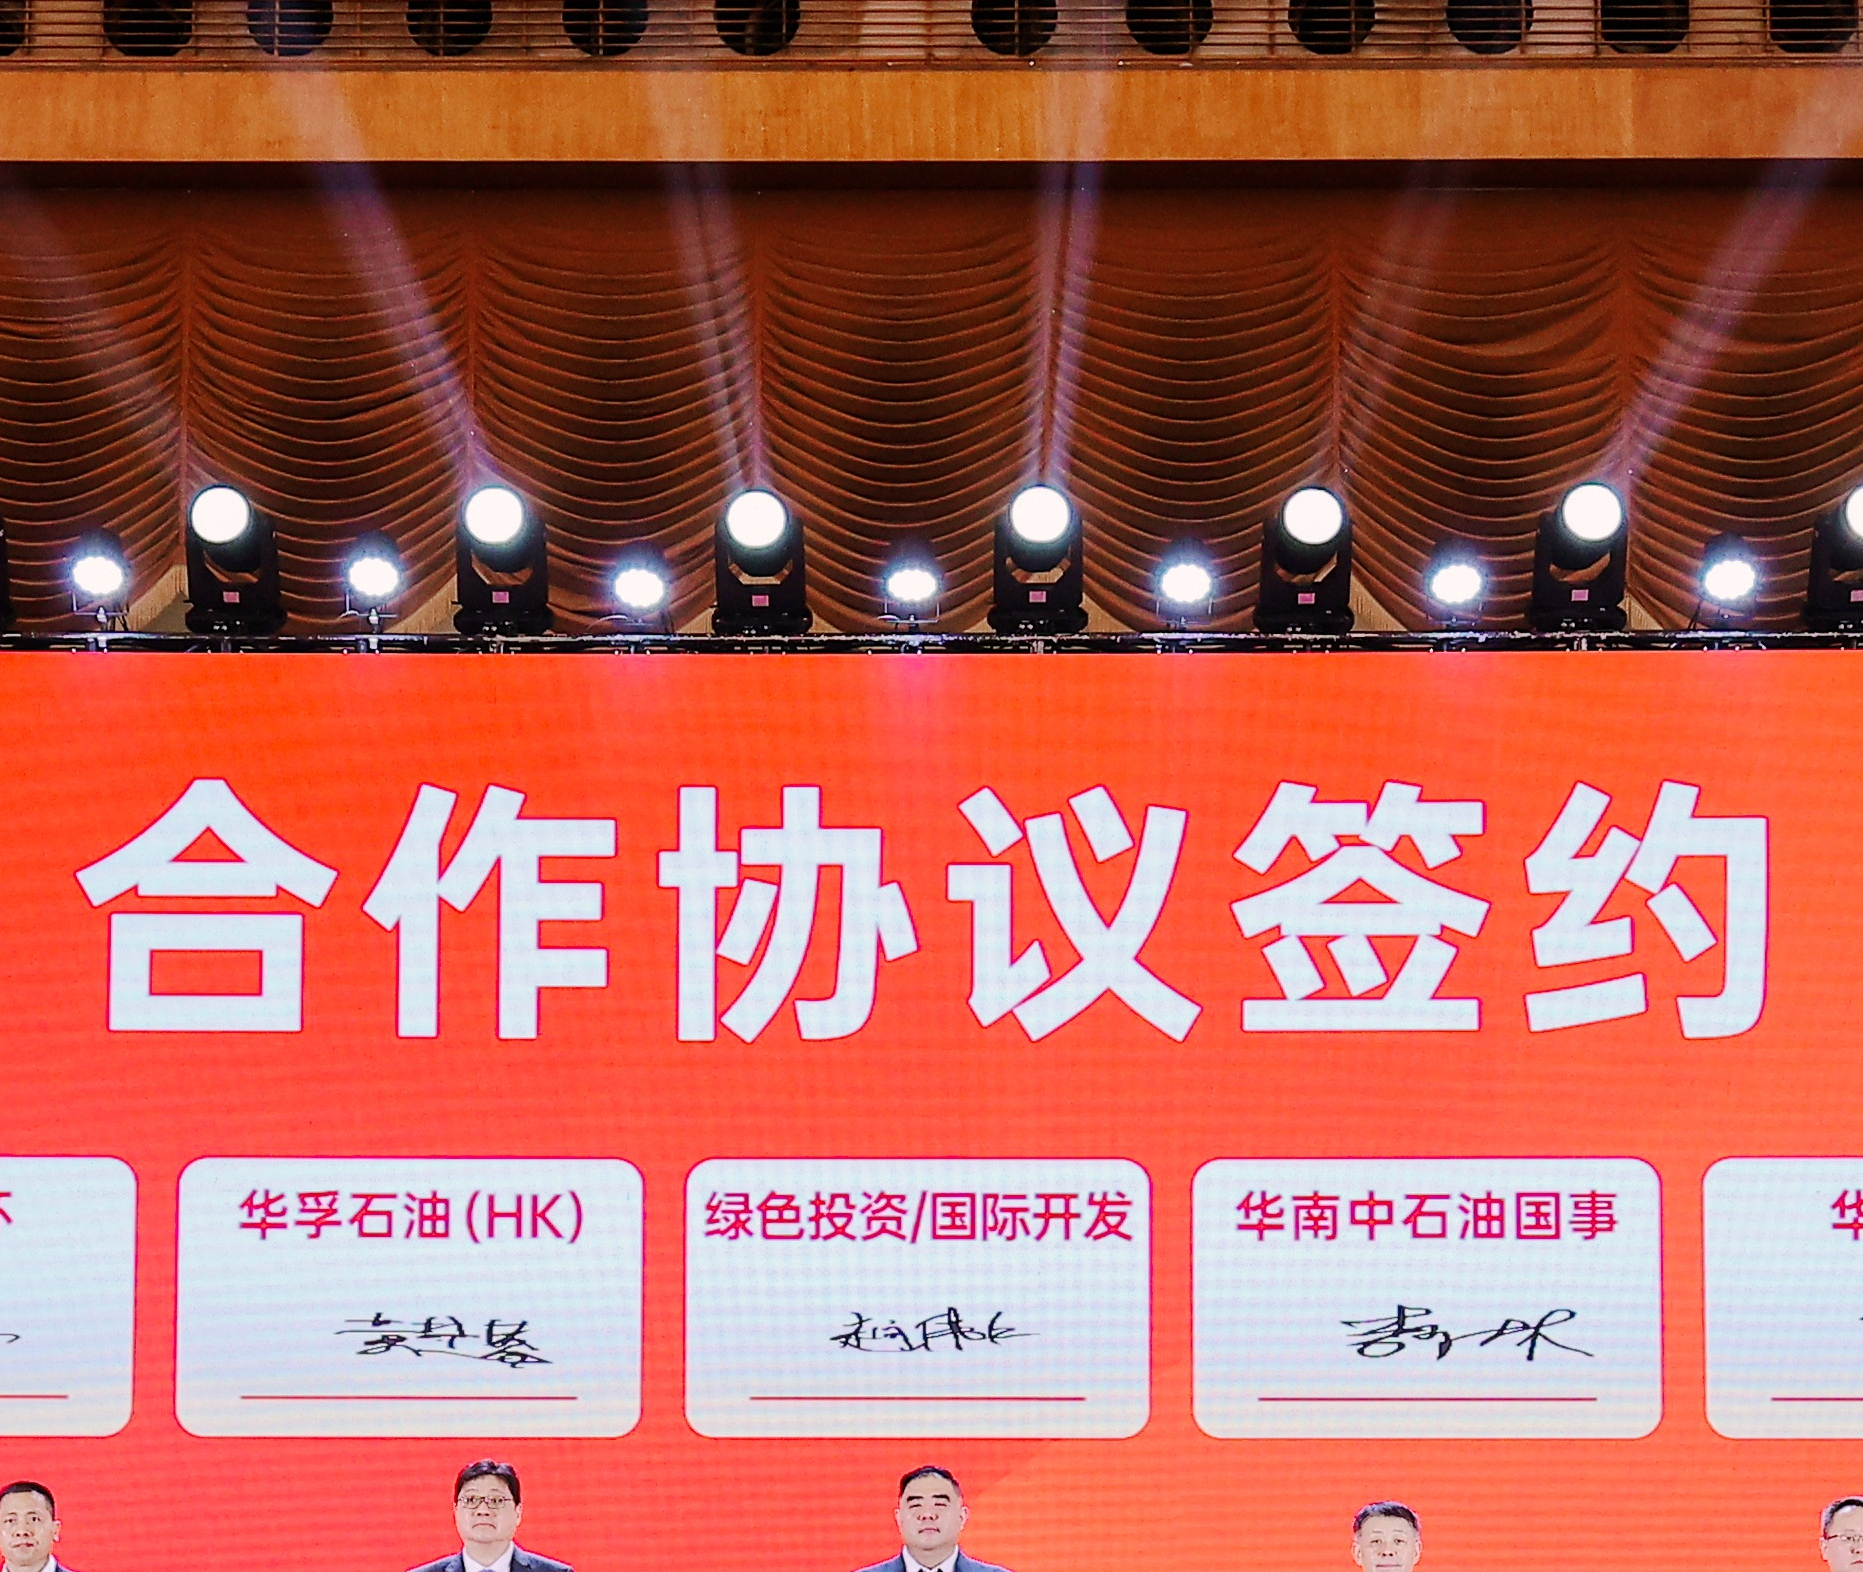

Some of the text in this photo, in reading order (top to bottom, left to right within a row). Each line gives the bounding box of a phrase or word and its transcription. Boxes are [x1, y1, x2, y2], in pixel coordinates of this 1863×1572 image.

[75, 778, 1769, 1043] 合作协议签约
[238, 1189, 584, 1243] 华孚石油(HK)
[704, 1190, 1134, 1243] 绿色投资/国际开发
[1236, 1189, 1618, 1242] 华南中石油国事
